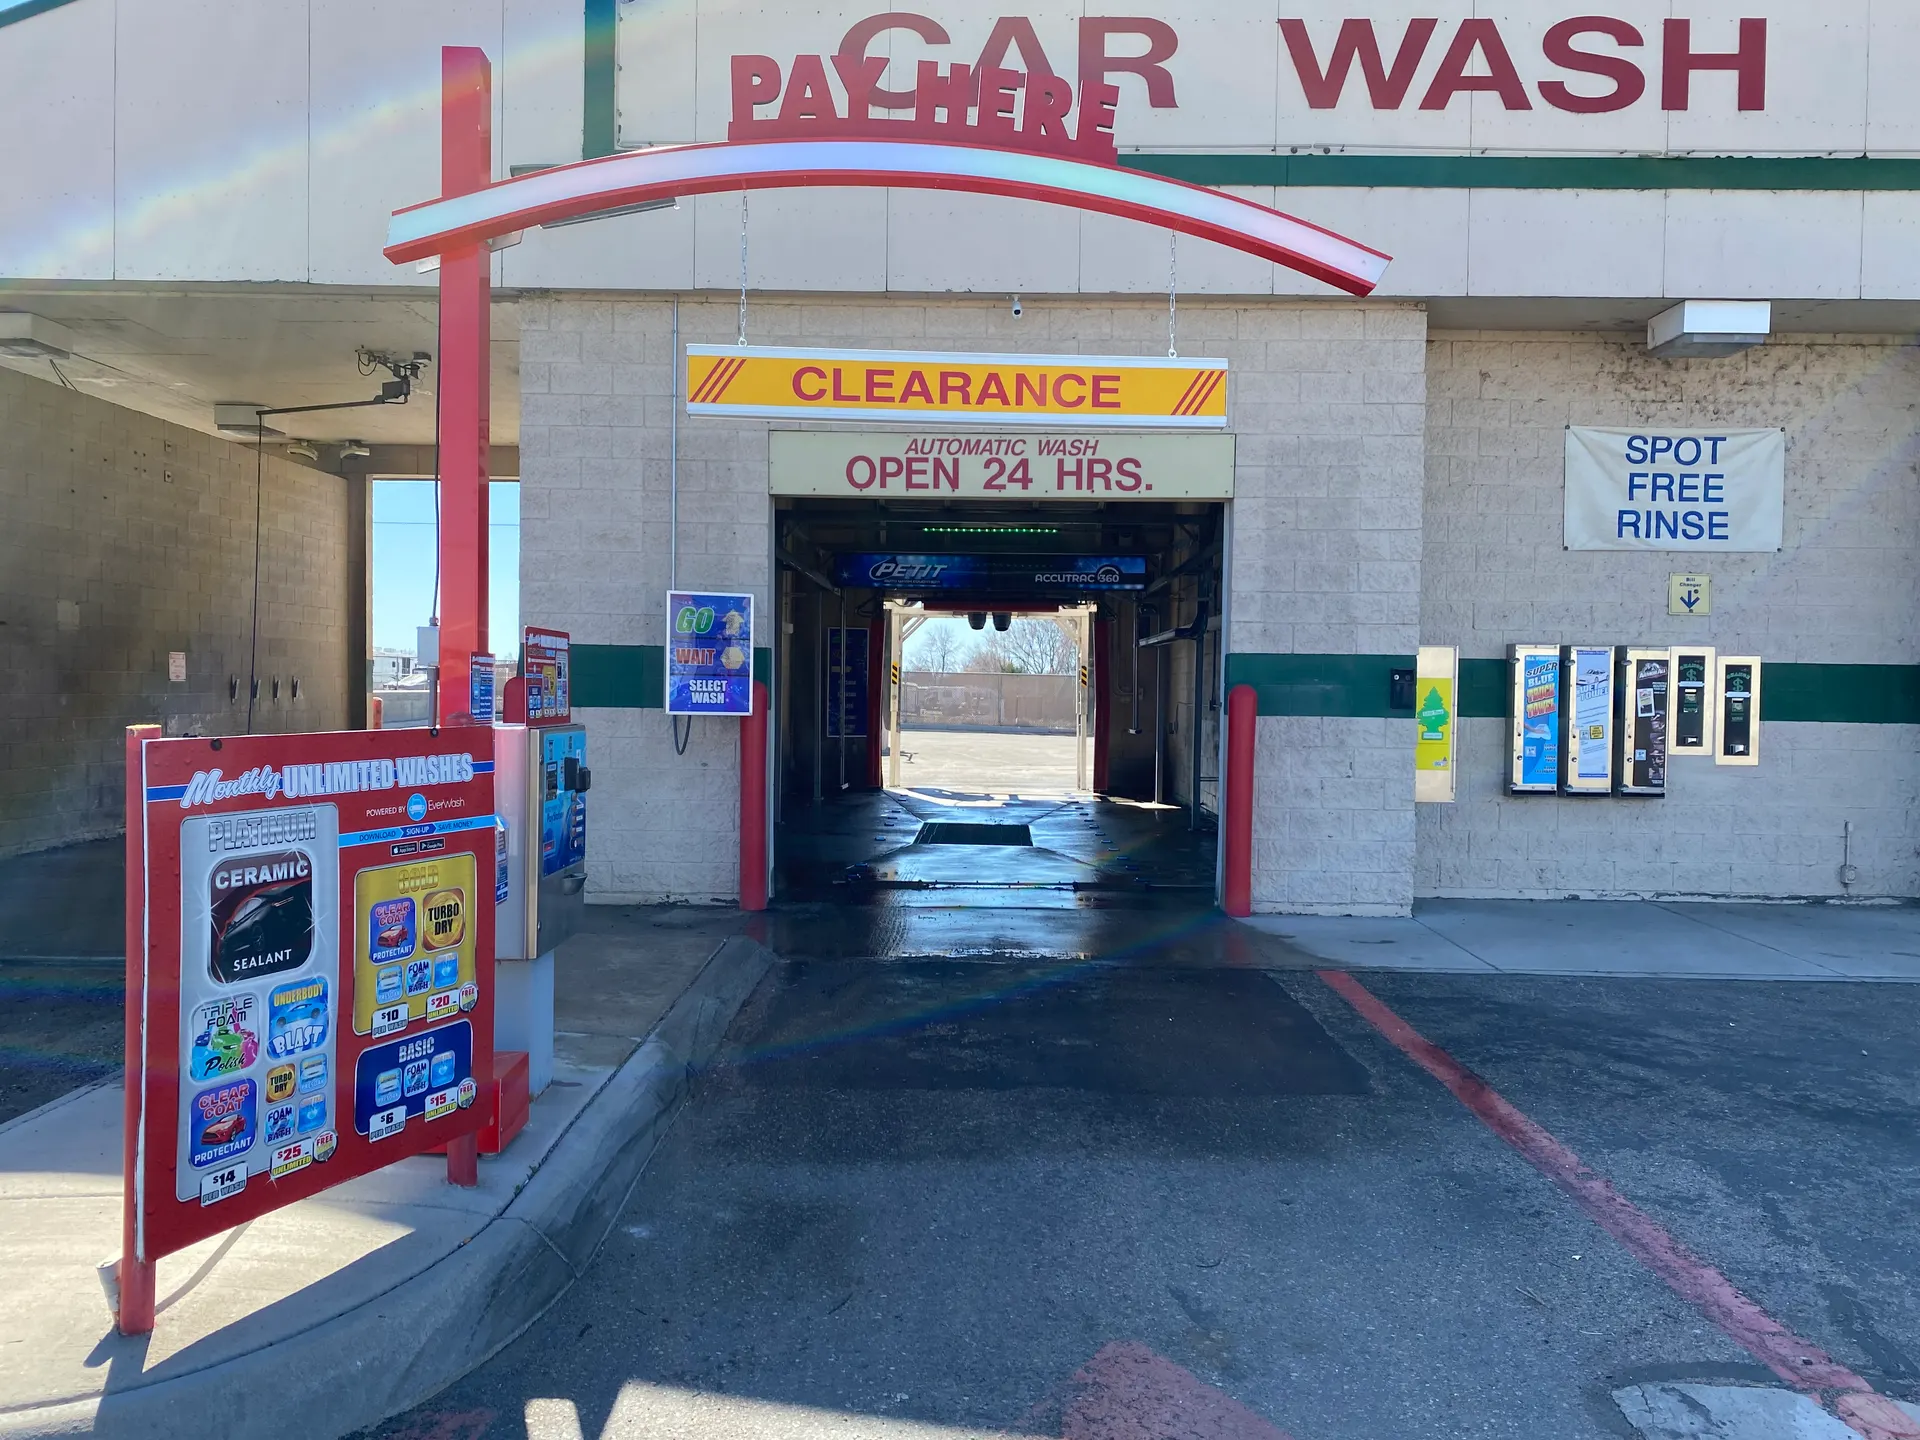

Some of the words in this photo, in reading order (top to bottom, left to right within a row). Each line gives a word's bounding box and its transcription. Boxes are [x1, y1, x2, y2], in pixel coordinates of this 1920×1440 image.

[838, 12, 1179, 109] CAR
[1279, 15, 1767, 114] WASH
[730, 55, 890, 123] PAY
[914, 60, 1120, 148] HERE
[791, 366, 1122, 409] CLEARANCE
[905, 438, 1027, 456] AUTOMATIC
[1037, 439, 1099, 456] WASH
[1624, 436, 1727, 467] SPOT
[845, 455, 962, 491] OPEN
[982, 457, 1033, 491] 24
[1056, 457, 1153, 491] HRS.
[1628, 473, 1724, 503] FREE
[1617, 511, 1729, 541] RINSE
[875, 562, 948, 578] PETIT
[1035, 574, 1095, 583] ACCUTRAC
[1097, 573, 1120, 583] 360
[676, 606, 715, 634] GO
[676, 648, 716, 666] WAIT
[1526, 662, 1558, 677] SUPER
[689, 680, 728, 692] SELECT
[1528, 673, 1555, 688] BLUE
[692, 692, 725, 704] WASH
[1580, 688, 1608, 701] TOWEL
[1527, 698, 1556, 718] TOWEL
[180, 765, 281, 809] Monthly
[282, 759, 396, 799] UNLIMITED
[395, 752, 475, 788] WASHES
[366, 807, 397, 817] POWERED
[428, 798, 465, 811] EverWash
[209, 811, 317, 852] PLATINUM
[360, 831, 396, 841] DOWNLOAD
[406, 826, 430, 835] SIGN-UP
[453, 820, 474, 829] MONEY
[215, 860, 308, 889] CERAMIC
[398, 864, 439, 895] GOLD
[375, 901, 411, 917] CLEAR
[428, 903, 460, 921] TURBO
[379, 913, 407, 927] COAT
[435, 919, 454, 936] DRY
[233, 949, 292, 971] SEALANT
[373, 945, 413, 960] PROTECTANT
[408, 961, 429, 974] FOAM
[273, 983, 324, 1007] UNDERBODY
[408, 981, 429, 993] BATH
[461, 987, 475, 997] FREE
[201, 997, 252, 1019] TRIPLE
[431, 995, 450, 1008] $20
[207, 1010, 246, 1029] FOAM
[381, 1009, 399, 1022] $10
[428, 1004, 459, 1019] UNLIMITED
[373, 1024, 387, 1036] PER
[272, 1025, 323, 1054] BLAST
[399, 1036, 435, 1063] BASIC
[204, 1052, 246, 1077] Polish
[407, 1062, 427, 1076] FOAM
[270, 1071, 293, 1086] TURBO
[274, 1081, 289, 1094] DRY
[199, 1083, 249, 1109] CLEAR
[407, 1084, 426, 1095] BATH
[460, 1083, 473, 1095] FREE
[430, 1093, 446, 1106] $15
[203, 1097, 244, 1121] COAT
[268, 1107, 293, 1123] FOAM
[381, 1112, 394, 1124] $6
[426, 1102, 457, 1119] UNLIMITED
[267, 1126, 292, 1142] BATH
[316, 1134, 333, 1147] FREE
[194, 1136, 252, 1165] PROTECTANT
[277, 1144, 302, 1162] $25
[273, 1155, 312, 1177] UNLIMITED
[212, 1169, 236, 1186] $14
[203, 1190, 219, 1204] PER
[219, 1180, 246, 1199] WASH
